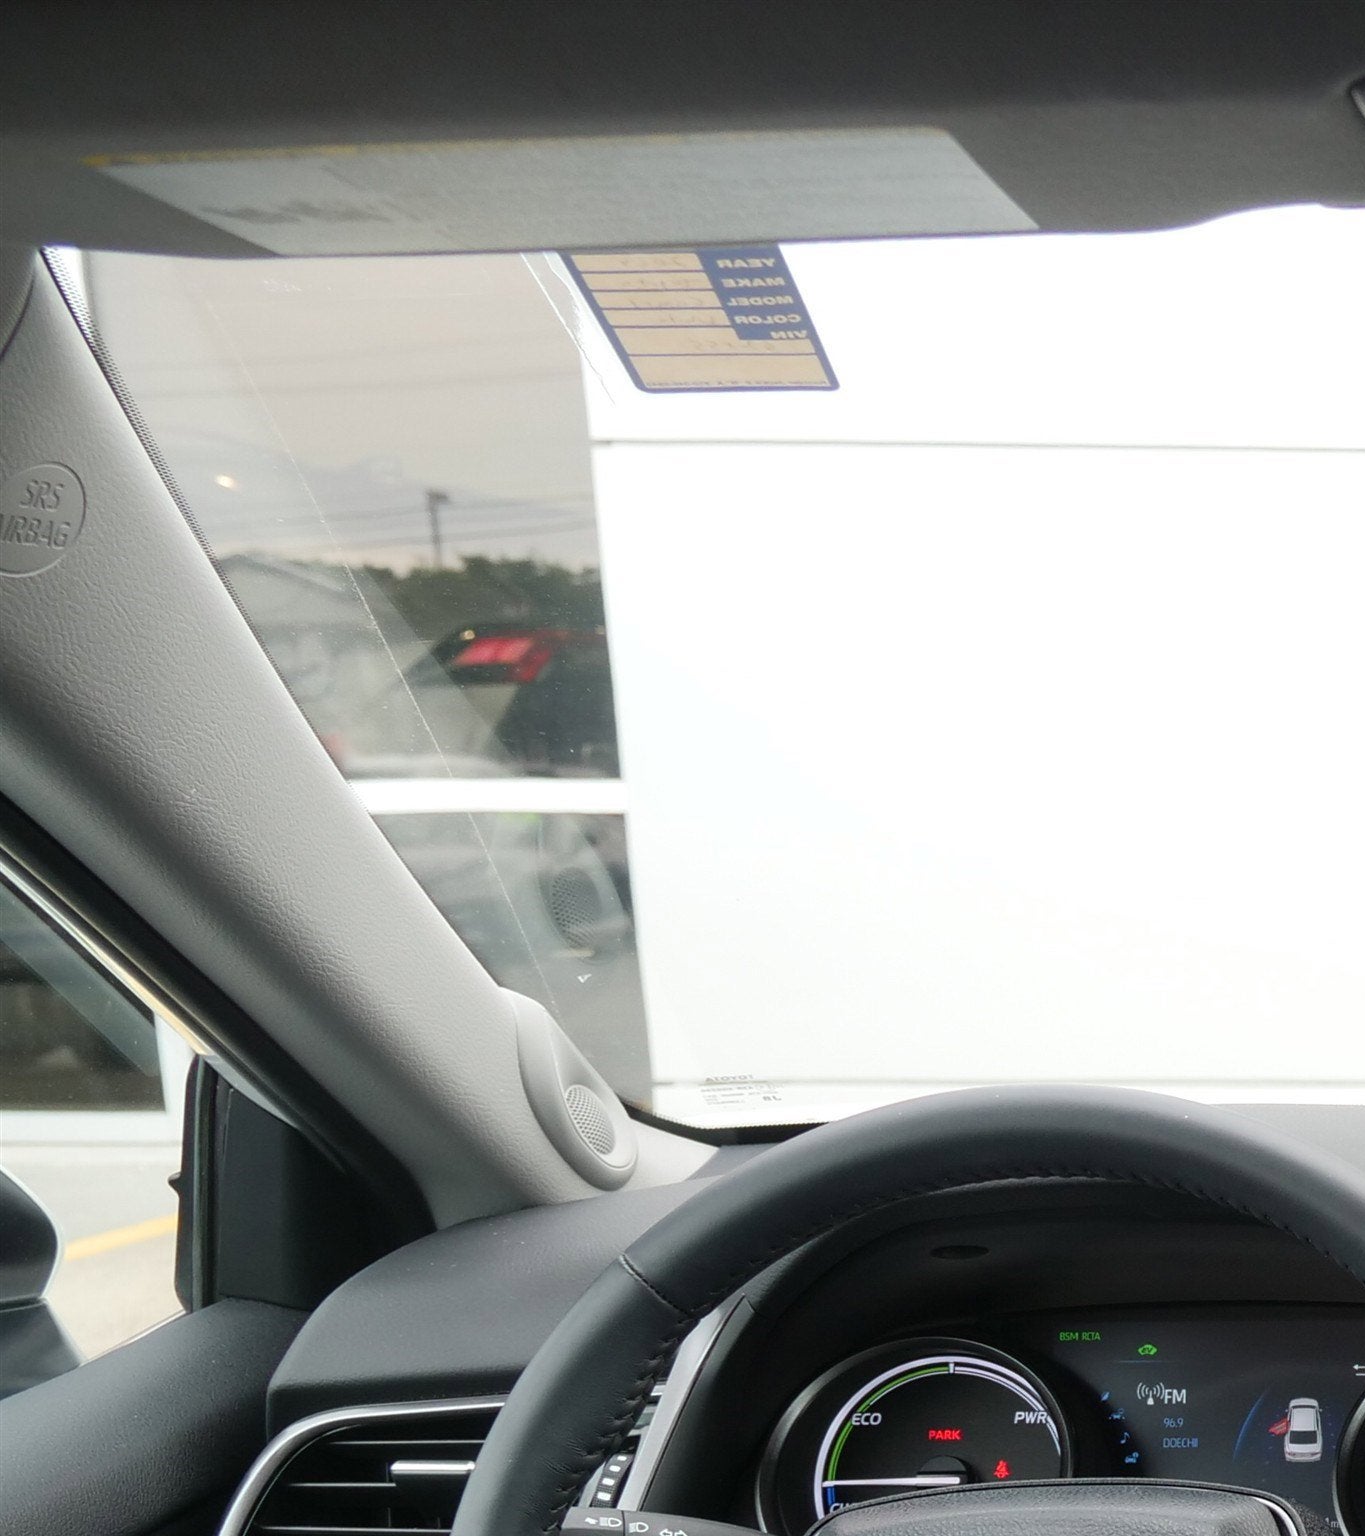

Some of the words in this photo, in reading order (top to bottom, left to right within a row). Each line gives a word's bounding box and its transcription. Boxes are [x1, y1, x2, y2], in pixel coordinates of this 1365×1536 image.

[19, 479, 64, 511] SRS
[1059, 1332, 1078, 1341] BSM
[1082, 1332, 1101, 1341] RCTA
[1164, 1389, 1186, 1404] FM
[851, 1413, 882, 1426] ECO
[1014, 1411, 1046, 1424] PWR
[1164, 1418, 1183, 1428] 96.9
[928, 1430, 961, 1441] PARK
